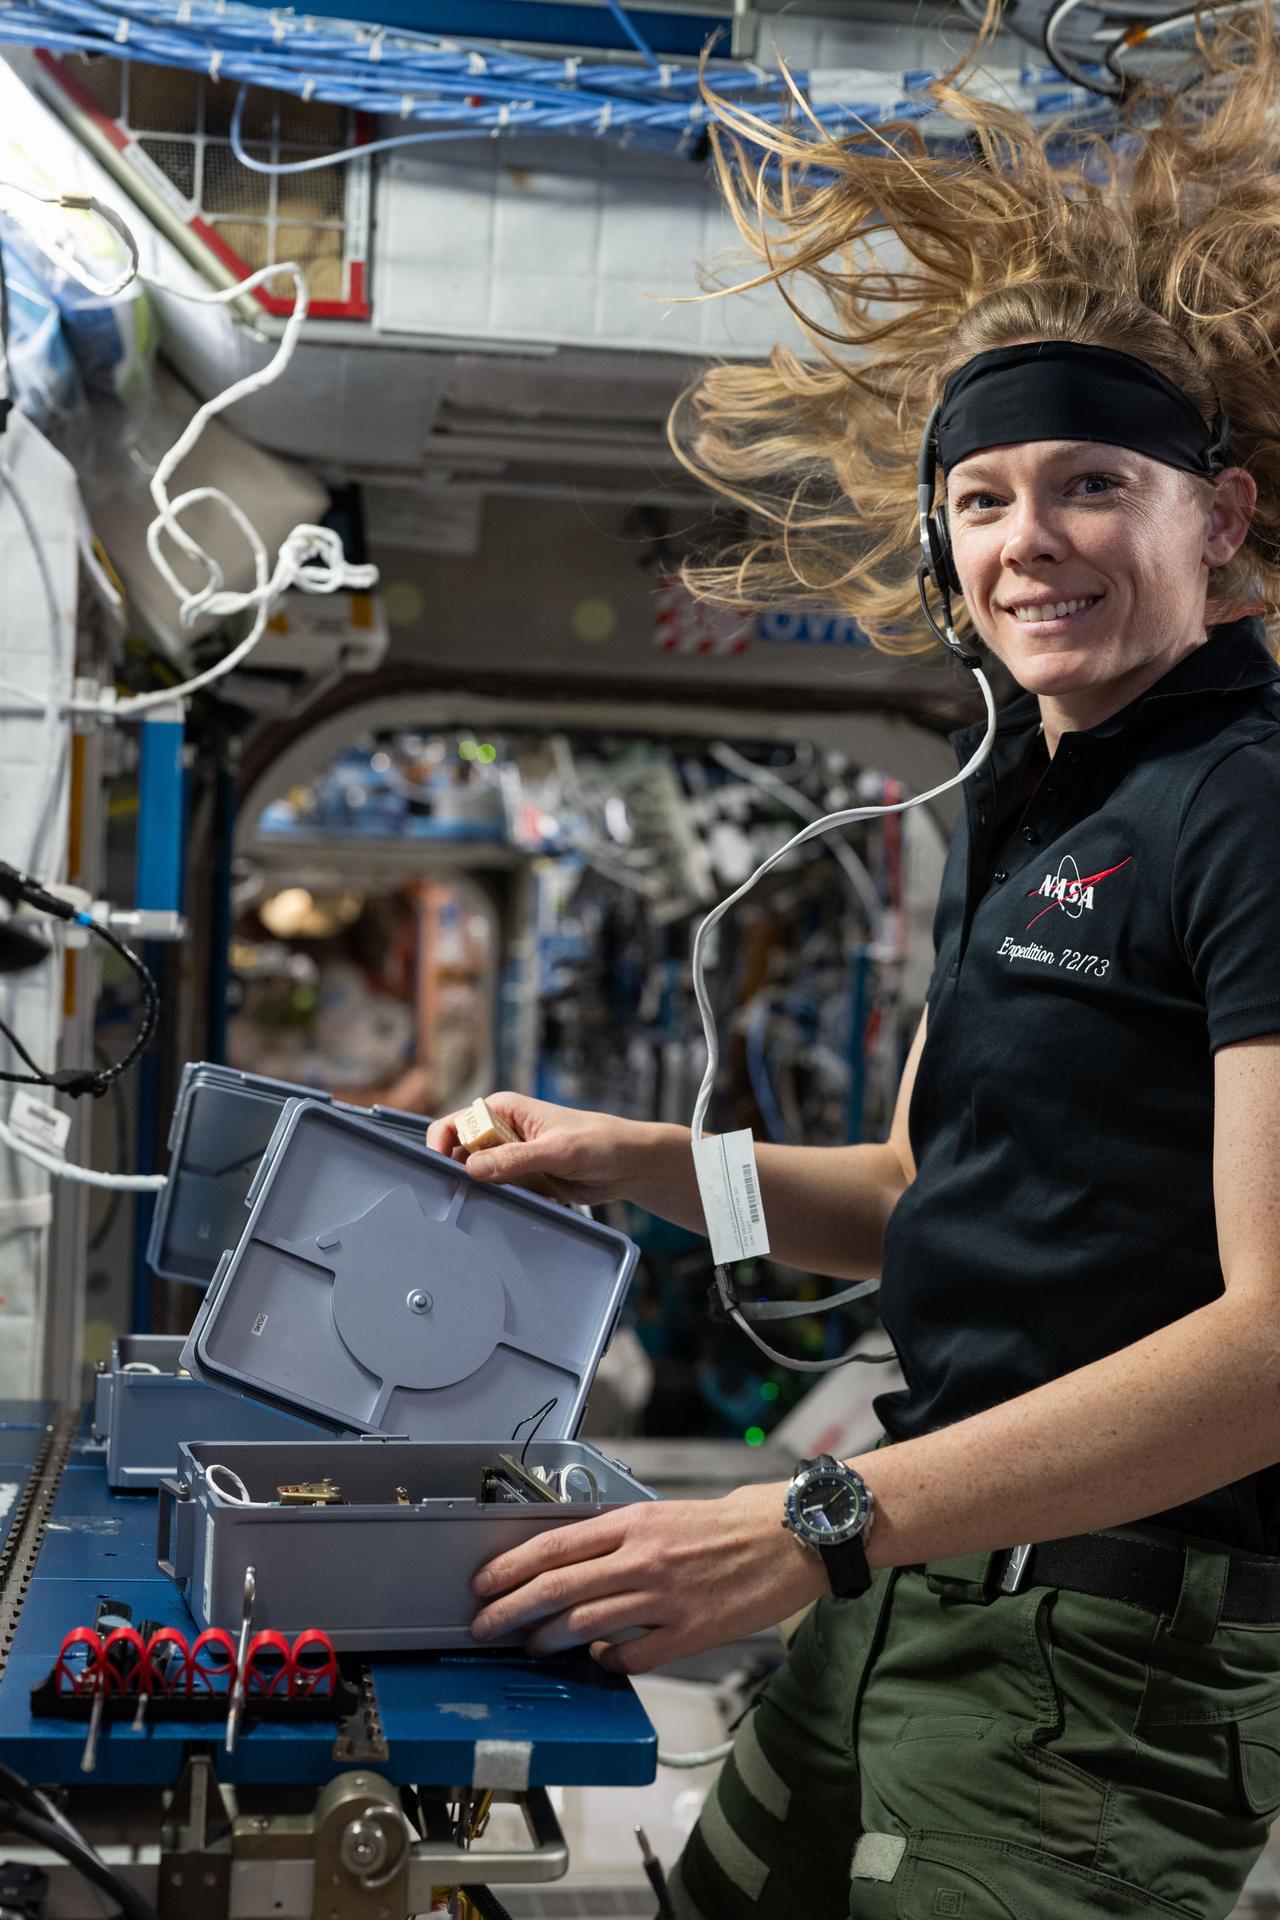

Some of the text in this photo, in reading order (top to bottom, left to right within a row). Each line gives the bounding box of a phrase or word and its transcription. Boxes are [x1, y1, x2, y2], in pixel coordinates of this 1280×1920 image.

[1038, 874, 1095, 910] NASA
[996, 936, 1110, 977] Expedition 72/73
